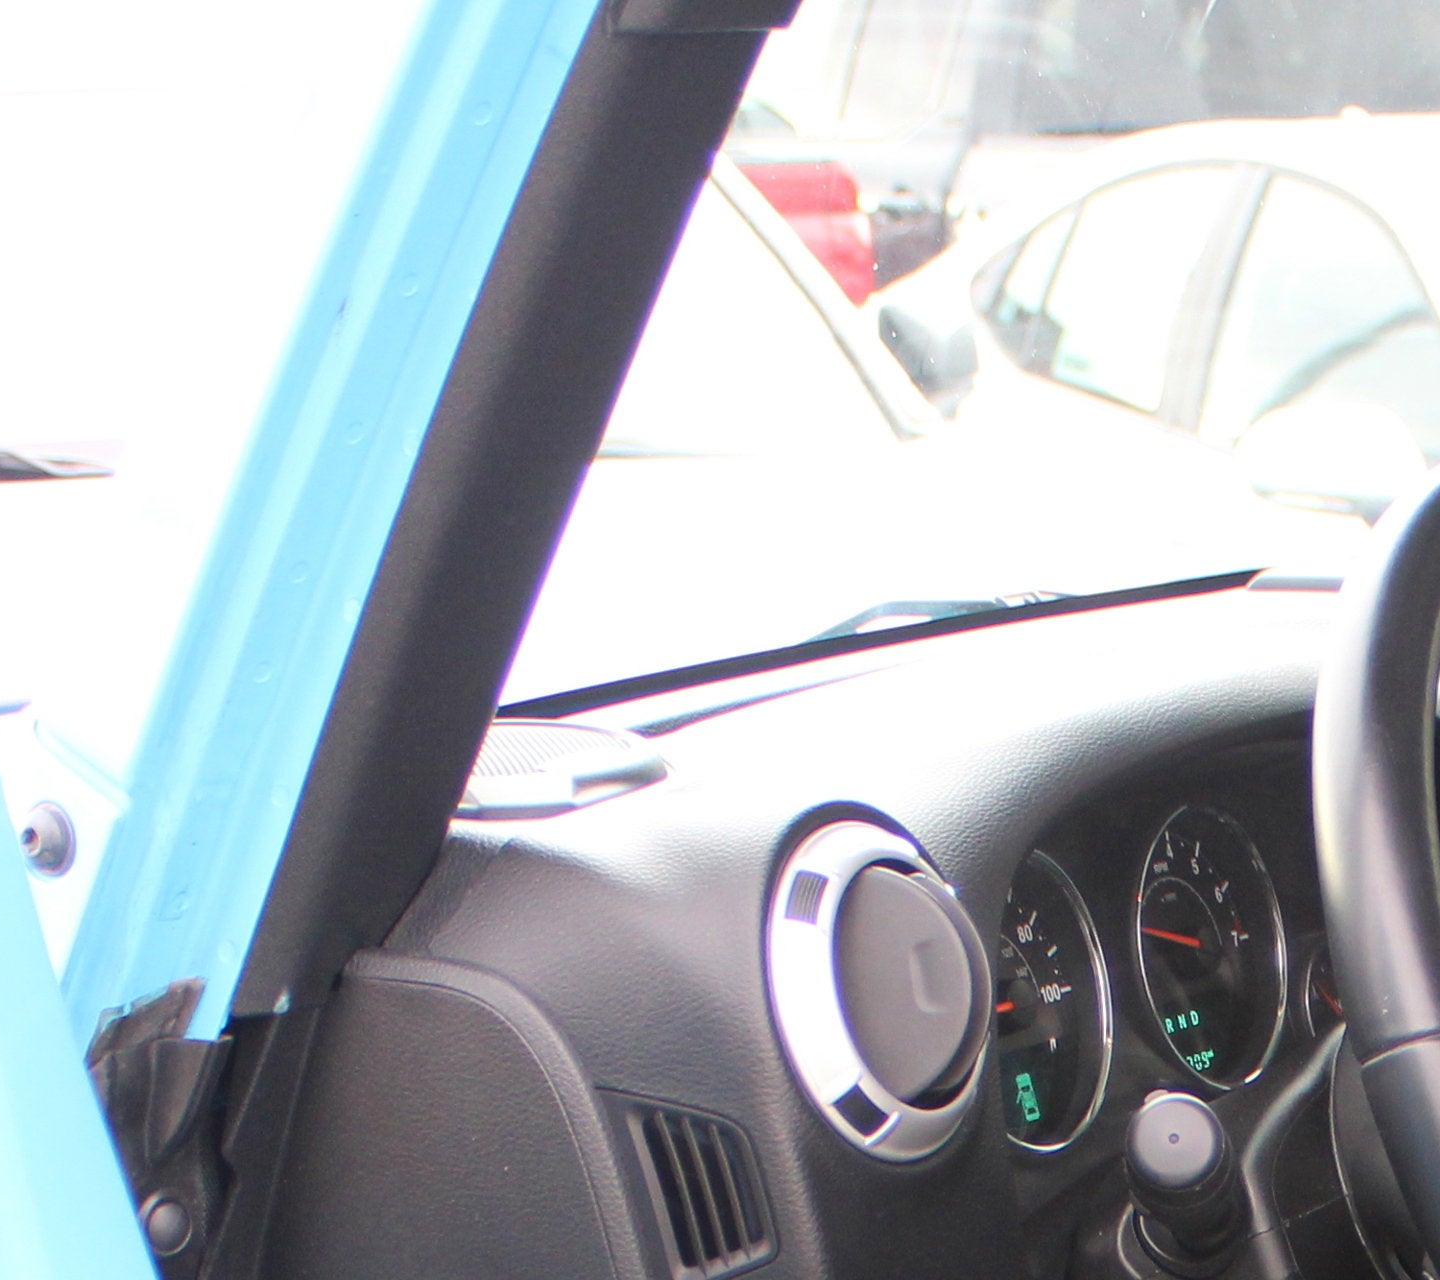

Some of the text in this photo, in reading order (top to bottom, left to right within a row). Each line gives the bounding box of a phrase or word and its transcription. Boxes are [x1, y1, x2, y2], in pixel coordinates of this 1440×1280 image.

[1191, 858, 1199, 875] 5
[1215, 886, 1223, 903] 6
[1017, 924, 1033, 943] 80
[1230, 931, 1238, 947] 7
[1041, 983, 1061, 1004] 100
